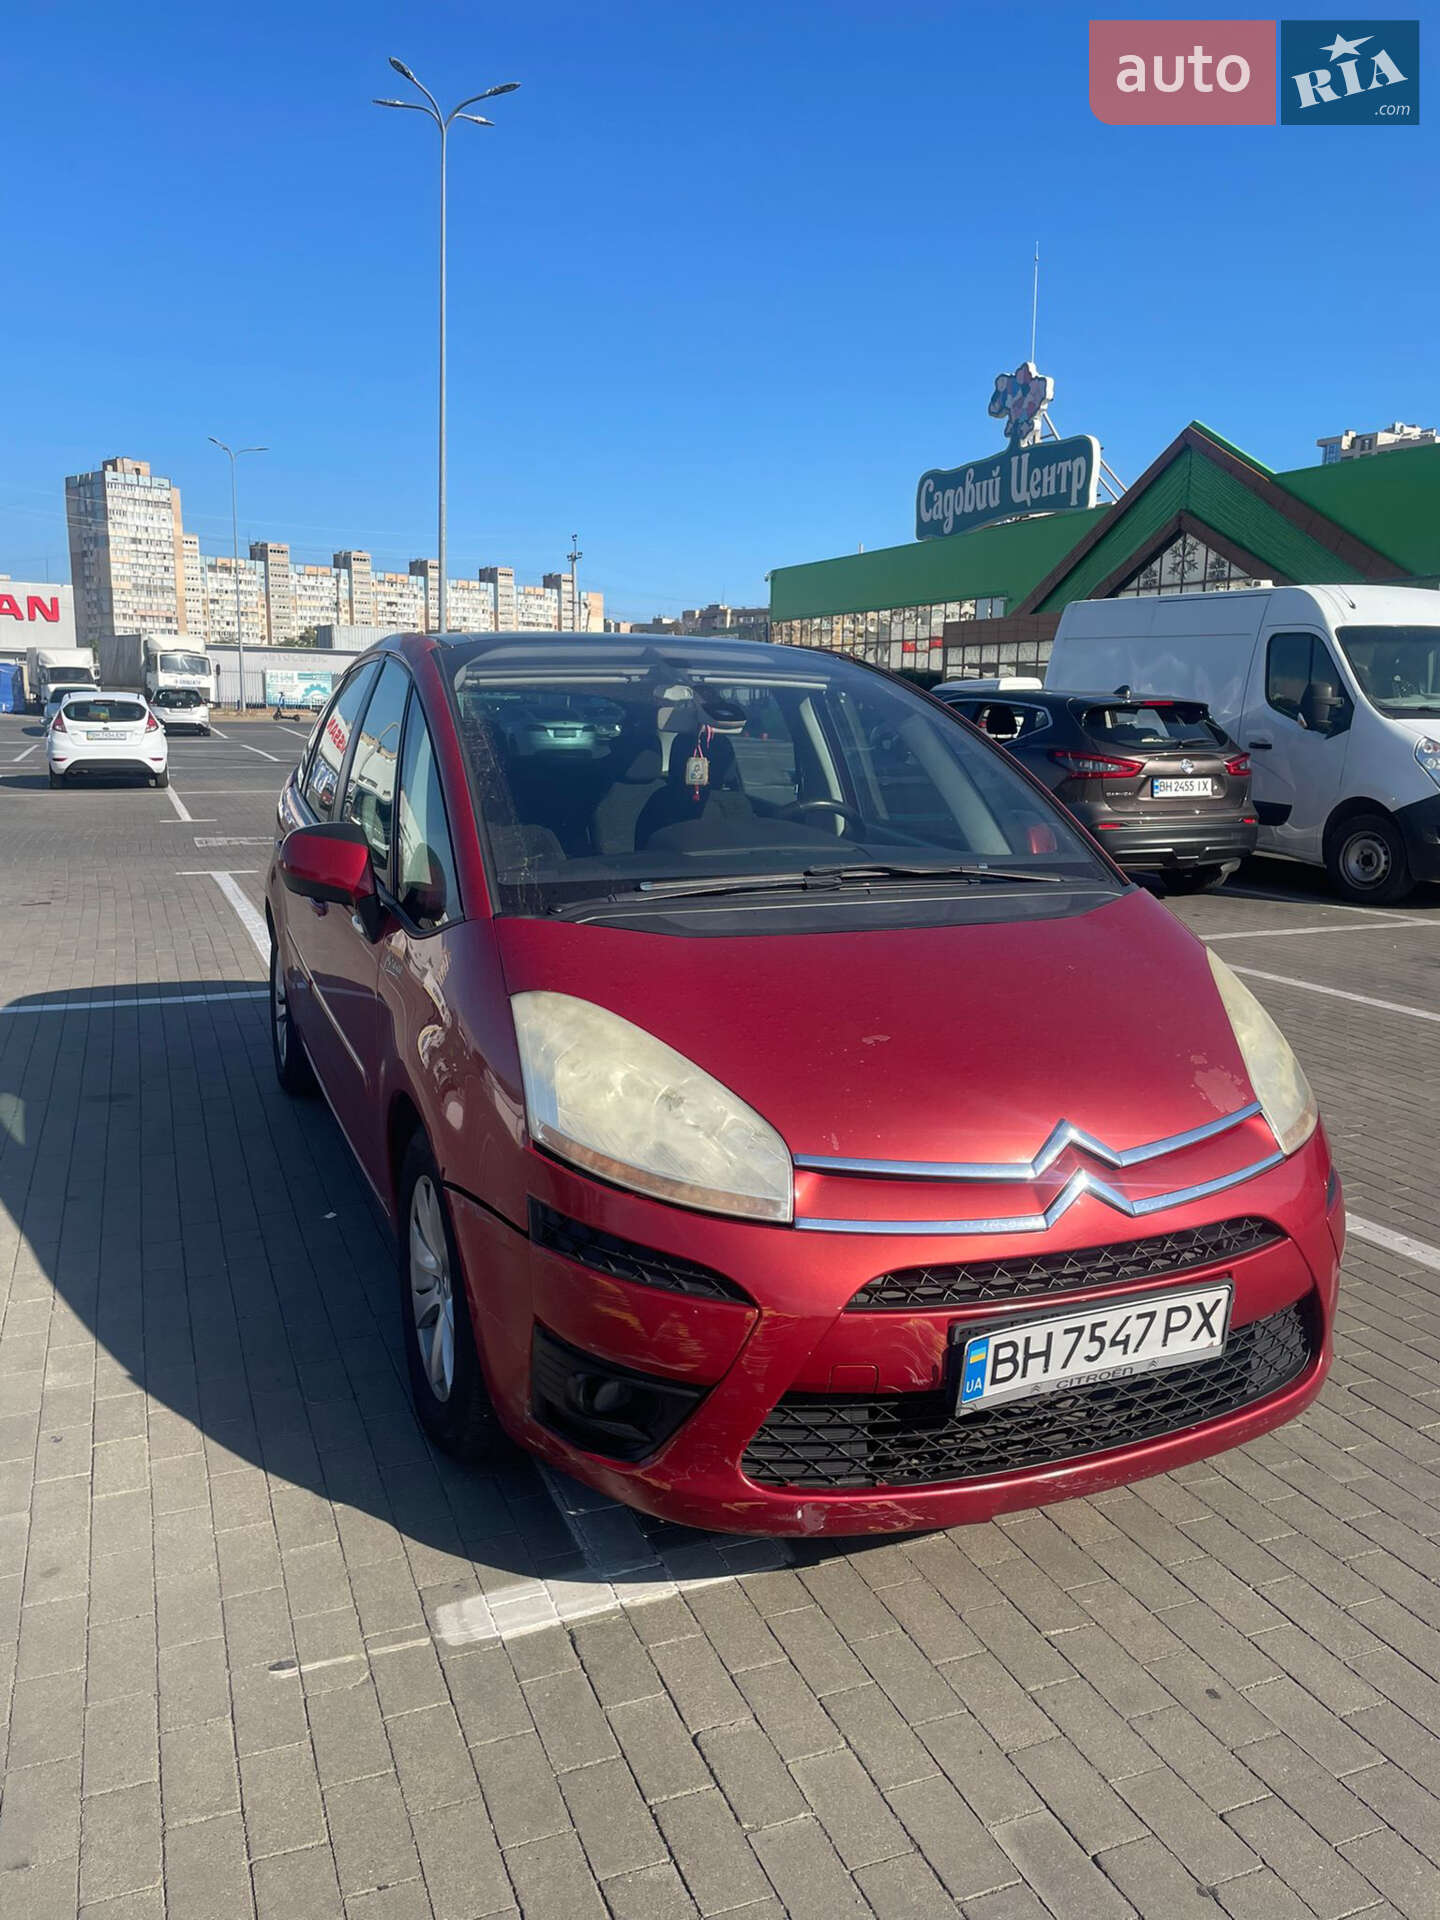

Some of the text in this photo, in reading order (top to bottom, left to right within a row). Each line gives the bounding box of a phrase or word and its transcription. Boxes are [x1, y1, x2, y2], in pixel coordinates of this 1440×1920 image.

[919, 452, 1087, 535] Садовий Центр
[965, 1379, 983, 1394] UA
